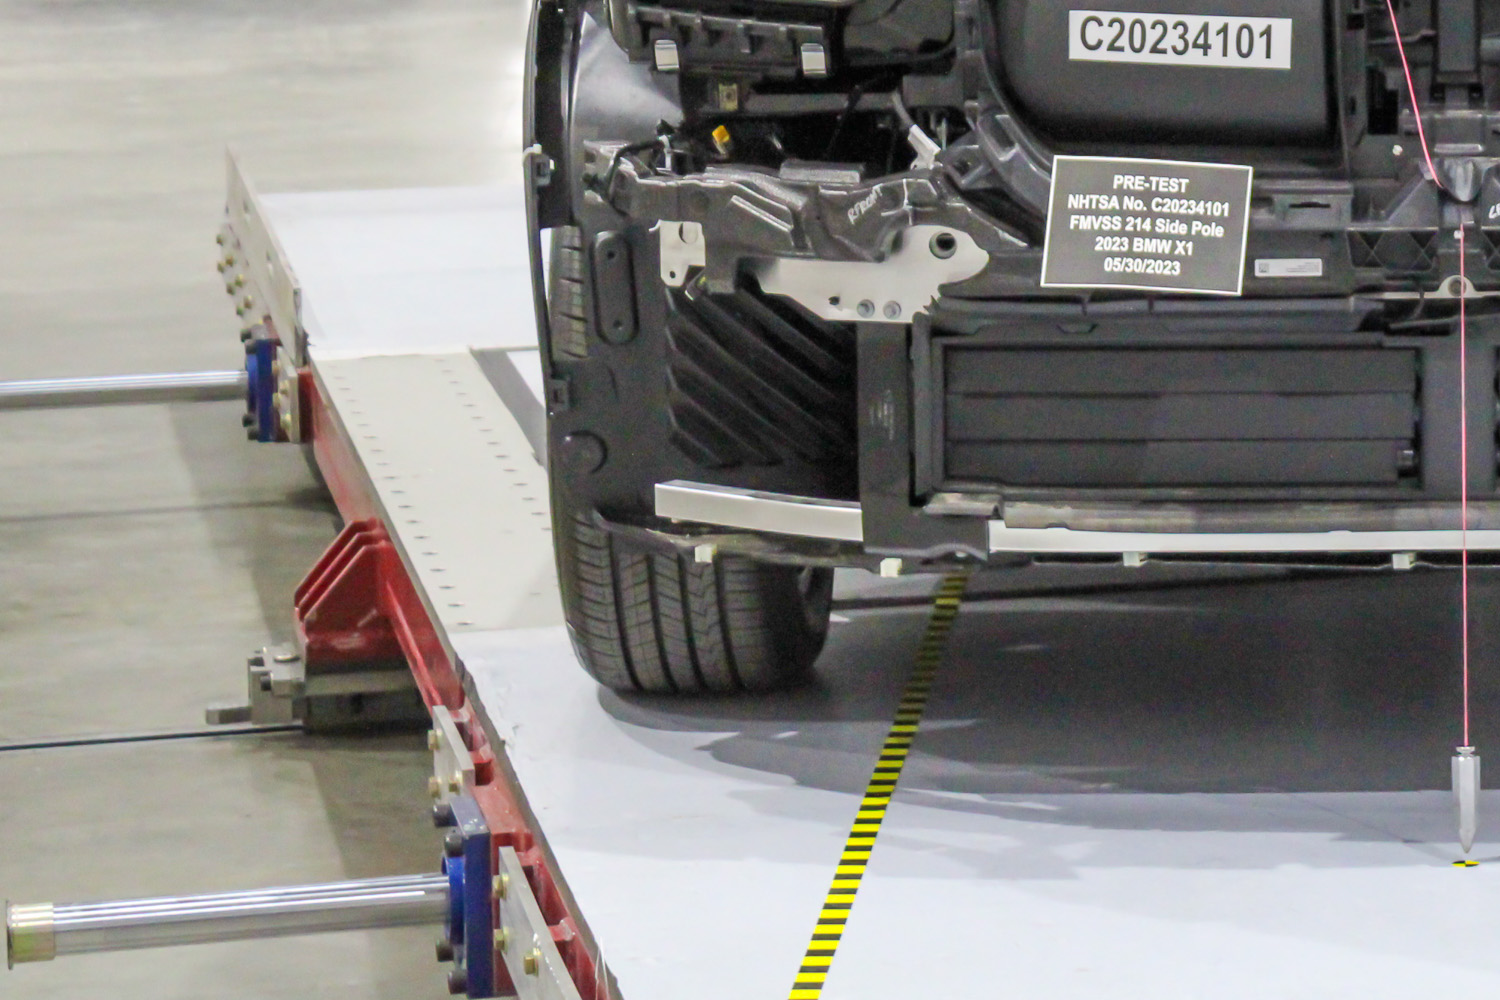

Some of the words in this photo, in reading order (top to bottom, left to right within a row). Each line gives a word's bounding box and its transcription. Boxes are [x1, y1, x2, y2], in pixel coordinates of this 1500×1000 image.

[1080, 15, 1273, 59] C20234101
[1113, 174, 1190, 193] PRE-TEST
[1067, 194, 1120, 210] NHTSA
[1122, 196, 1147, 211] No.
[1151, 197, 1230, 217] C20234101
[1069, 215, 1122, 231] FMVSS
[1125, 217, 1151, 232] 214
[1154, 218, 1188, 234] Side
[1191, 221, 1225, 238] Pole
[1094, 236, 1129, 251] 2023
[1132, 238, 1172, 254] BMW
[1174, 241, 1194, 256] X1
[1103, 257, 1181, 276] 05/30/2023
